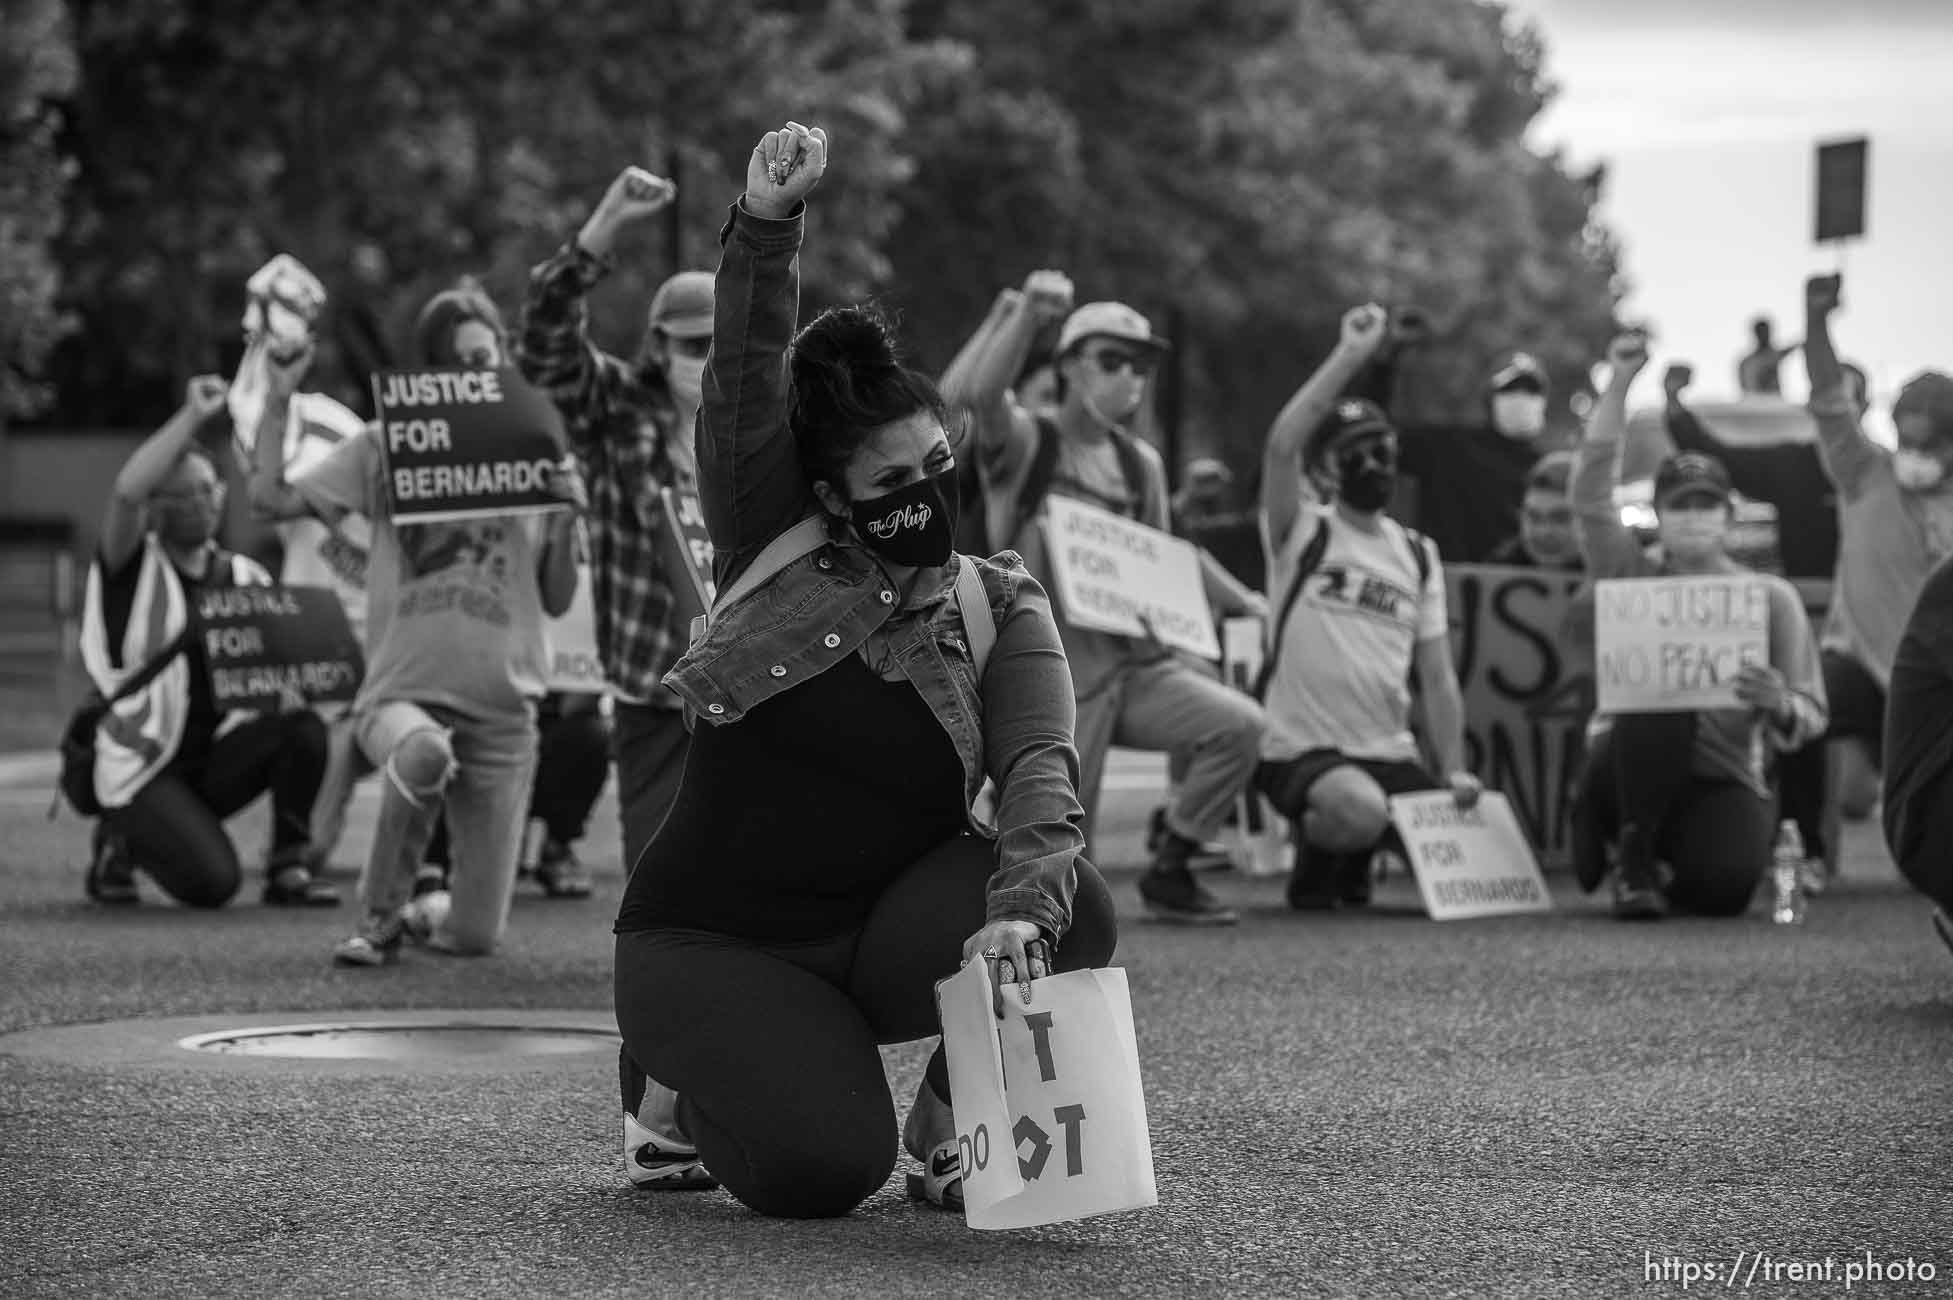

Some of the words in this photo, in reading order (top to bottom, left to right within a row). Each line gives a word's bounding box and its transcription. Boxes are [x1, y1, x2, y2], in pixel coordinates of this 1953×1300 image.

[383, 371, 503, 407] JUSTICE
[388, 418, 452, 454] FOR
[867, 519, 886, 534] The
[877, 504, 932, 539] Plug
[1068, 546, 1120, 580] FOR
[205, 625, 265, 660] FOR
[1601, 645, 1649, 688] NO
[1420, 839, 1465, 868] FOR
